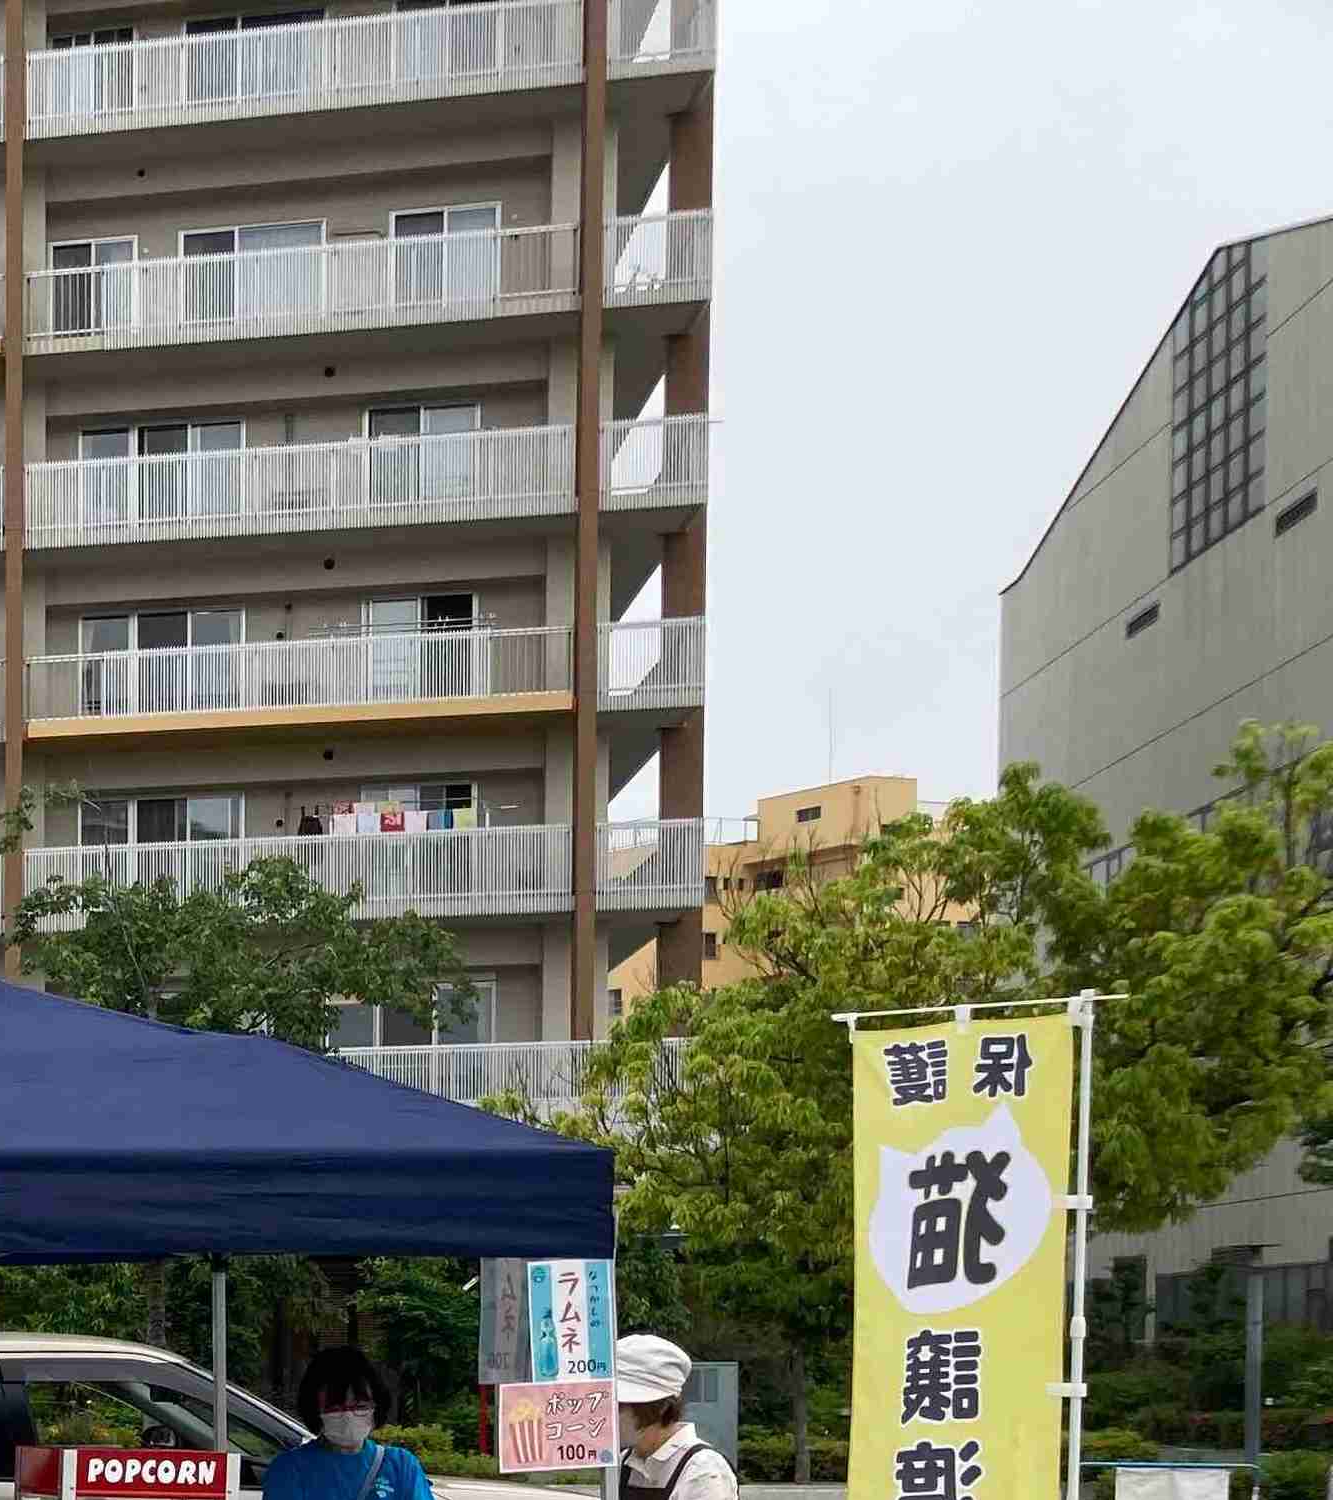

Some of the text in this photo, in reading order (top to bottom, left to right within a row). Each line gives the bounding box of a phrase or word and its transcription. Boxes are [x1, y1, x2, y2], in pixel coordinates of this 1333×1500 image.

[558, 1272, 582, 1353] ラムネ
[567, 1359, 607, 1374] 200円
[547, 1390, 609, 1416] ポップ
[547, 1417, 606, 1440] コーン
[558, 1444, 598, 1461] 100円
[87, 1458, 217, 1485] POPCORN
